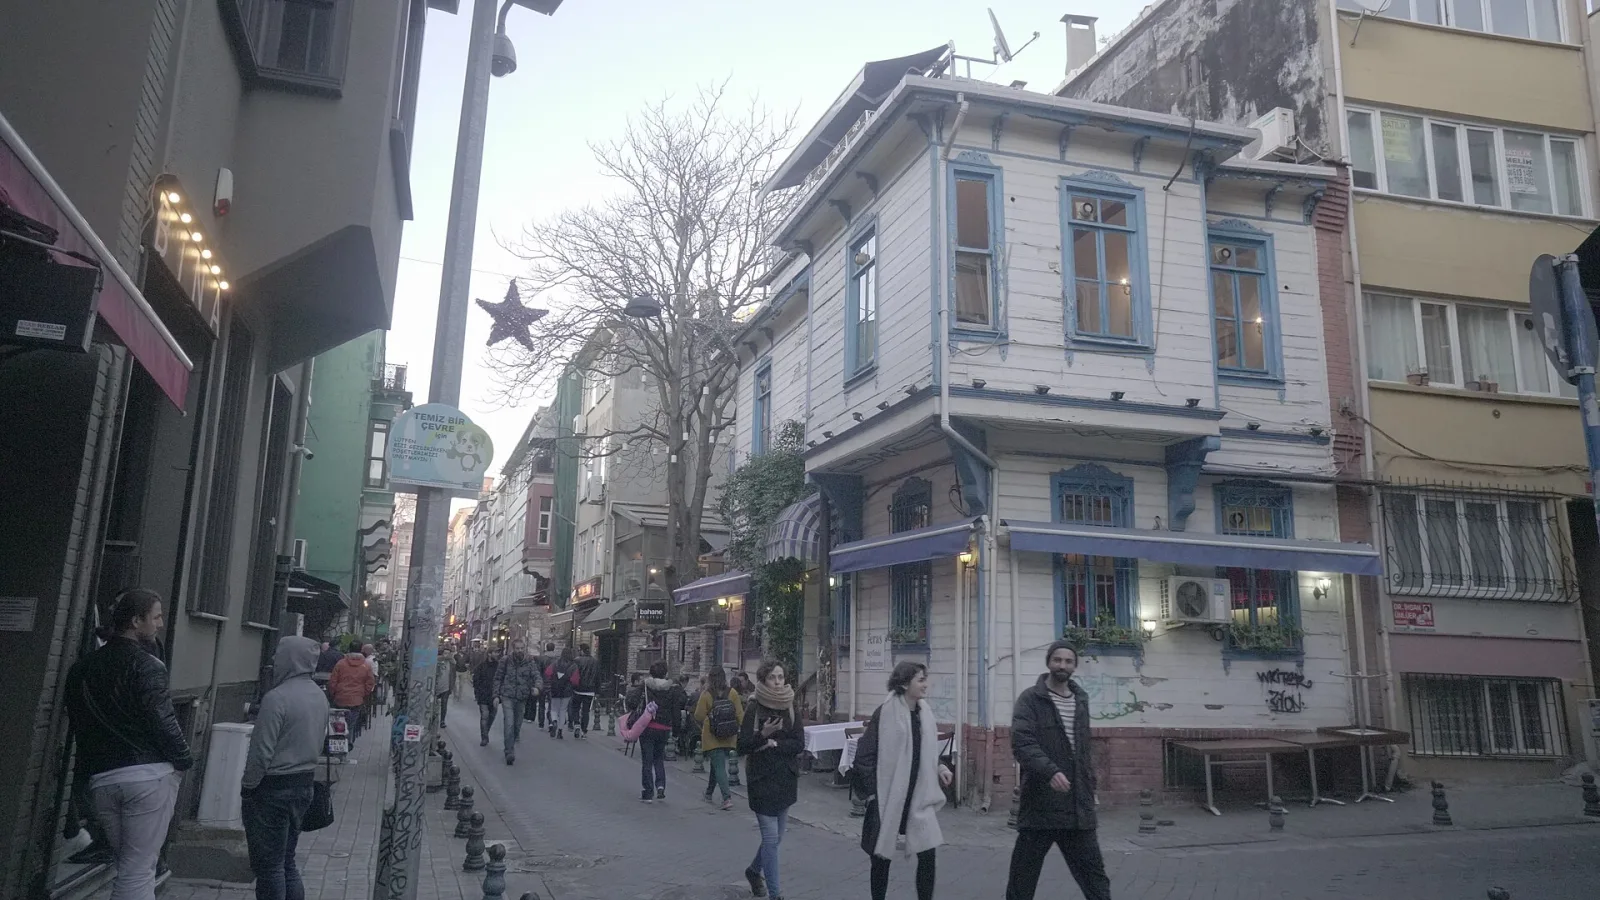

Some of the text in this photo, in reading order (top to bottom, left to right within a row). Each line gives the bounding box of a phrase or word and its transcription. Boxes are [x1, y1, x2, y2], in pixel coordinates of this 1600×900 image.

[414, 412, 465, 426] TEMİZ BİR
[421, 422, 455, 433] ÇEVRE
